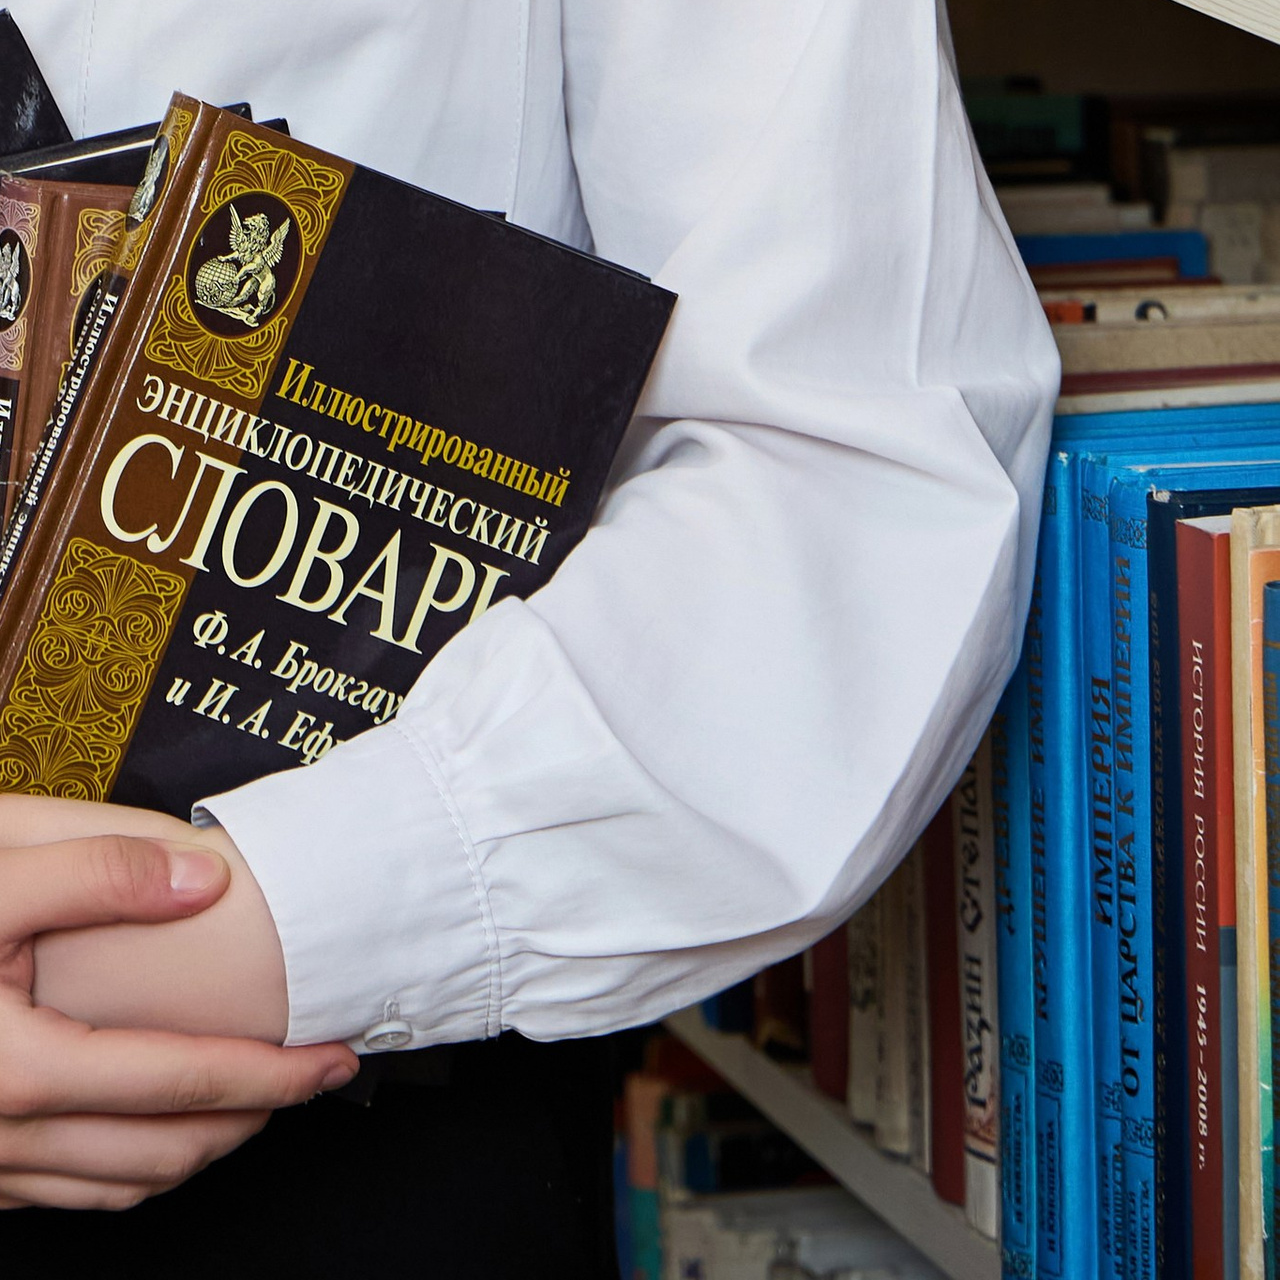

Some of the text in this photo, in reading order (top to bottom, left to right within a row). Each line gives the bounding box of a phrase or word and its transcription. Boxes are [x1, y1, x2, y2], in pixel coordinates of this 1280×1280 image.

[25, 291, 119, 508] Иллюстрированный
[135, 374, 551, 566] ЭНЦИКЛОПЕДИЧЕСКИЙ
[275, 356, 572, 509] Иллюстрированный
[164, 676, 193, 707] и
[192, 677, 240, 724] И.
[236, 697, 271, 740] А.
[191, 609, 228, 656] Ф.
[229, 628, 264, 670] А.
[1190, 638, 1207, 802] ИСТОРИЯ
[1090, 676, 1114, 929] ИМПЕРИЯ
[1113, 555, 1144, 1099] ОТ ЦАРСТВА К ИМПЕРИИ
[1192, 811, 1209, 954] РОССИИ
[1029, 788, 1050, 1022] КРУШЕНИЕ
[963, 952, 992, 1109] Разин
